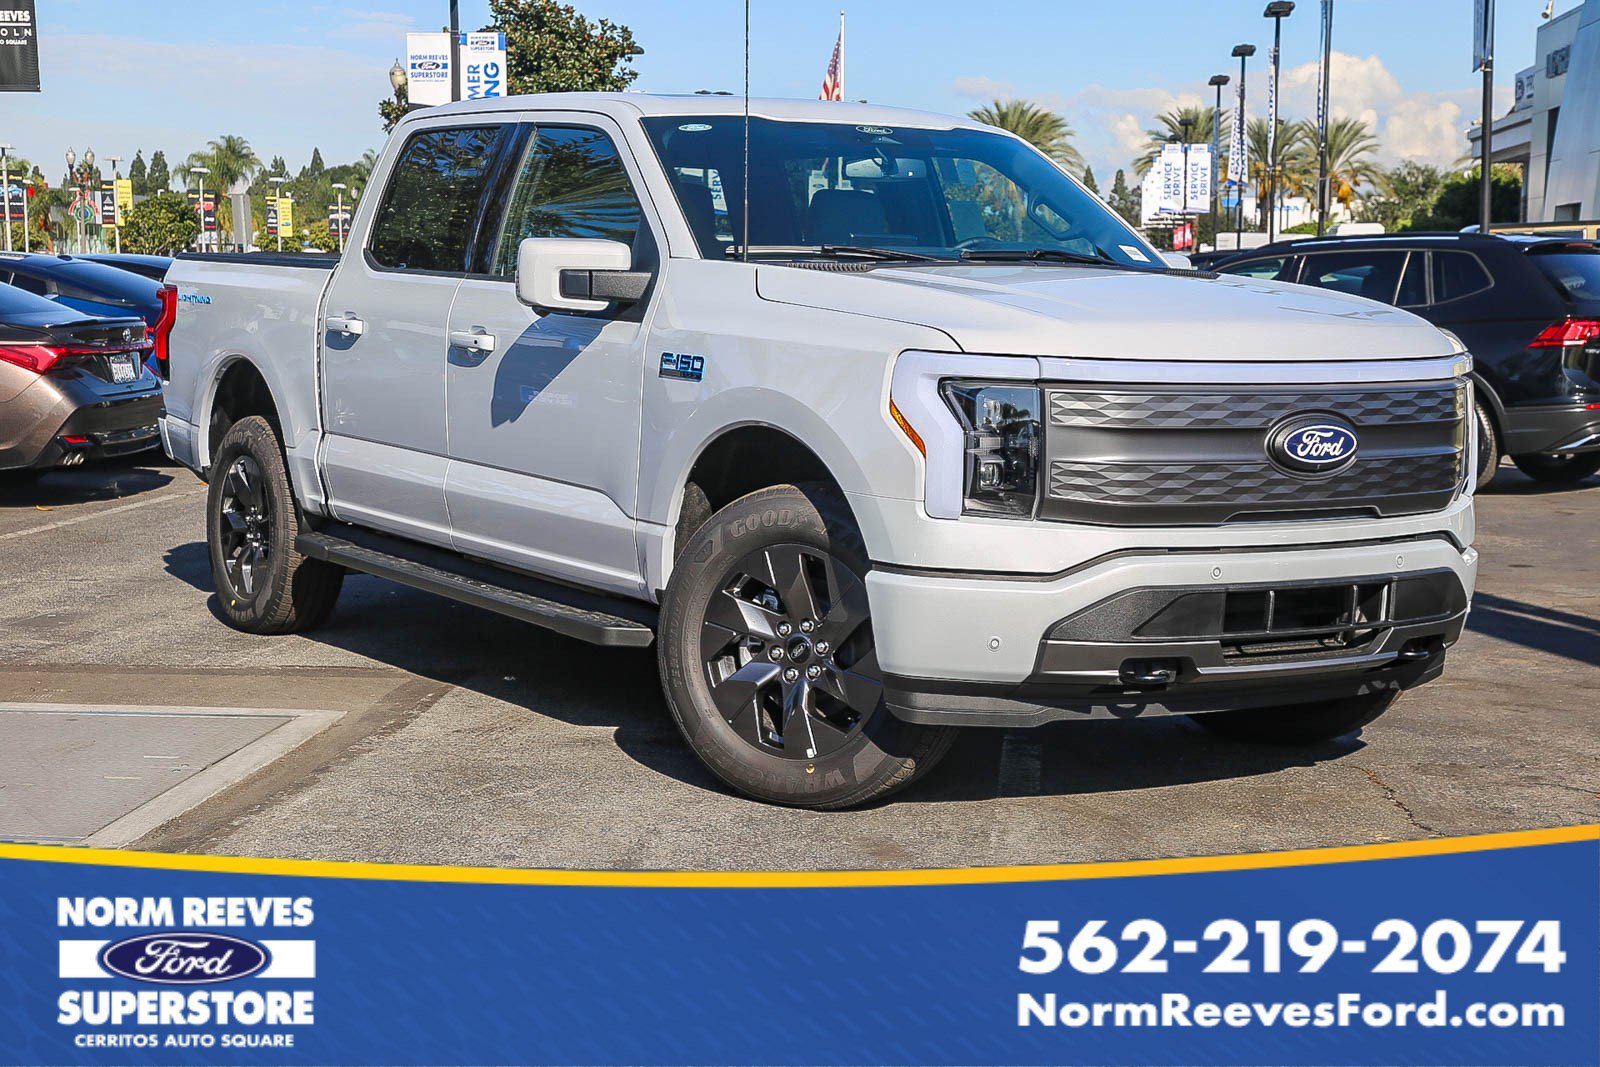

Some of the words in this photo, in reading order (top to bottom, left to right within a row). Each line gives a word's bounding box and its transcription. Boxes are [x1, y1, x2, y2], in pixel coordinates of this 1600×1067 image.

[1164, 162, 1173, 200] SERVICE
[1173, 167, 1182, 196] DRIVE
[1191, 162, 1199, 200] SERVICE
[1200, 166, 1208, 196] DRIVE
[660, 352, 704, 372] F-150
[1297, 431, 1345, 456] Ford
